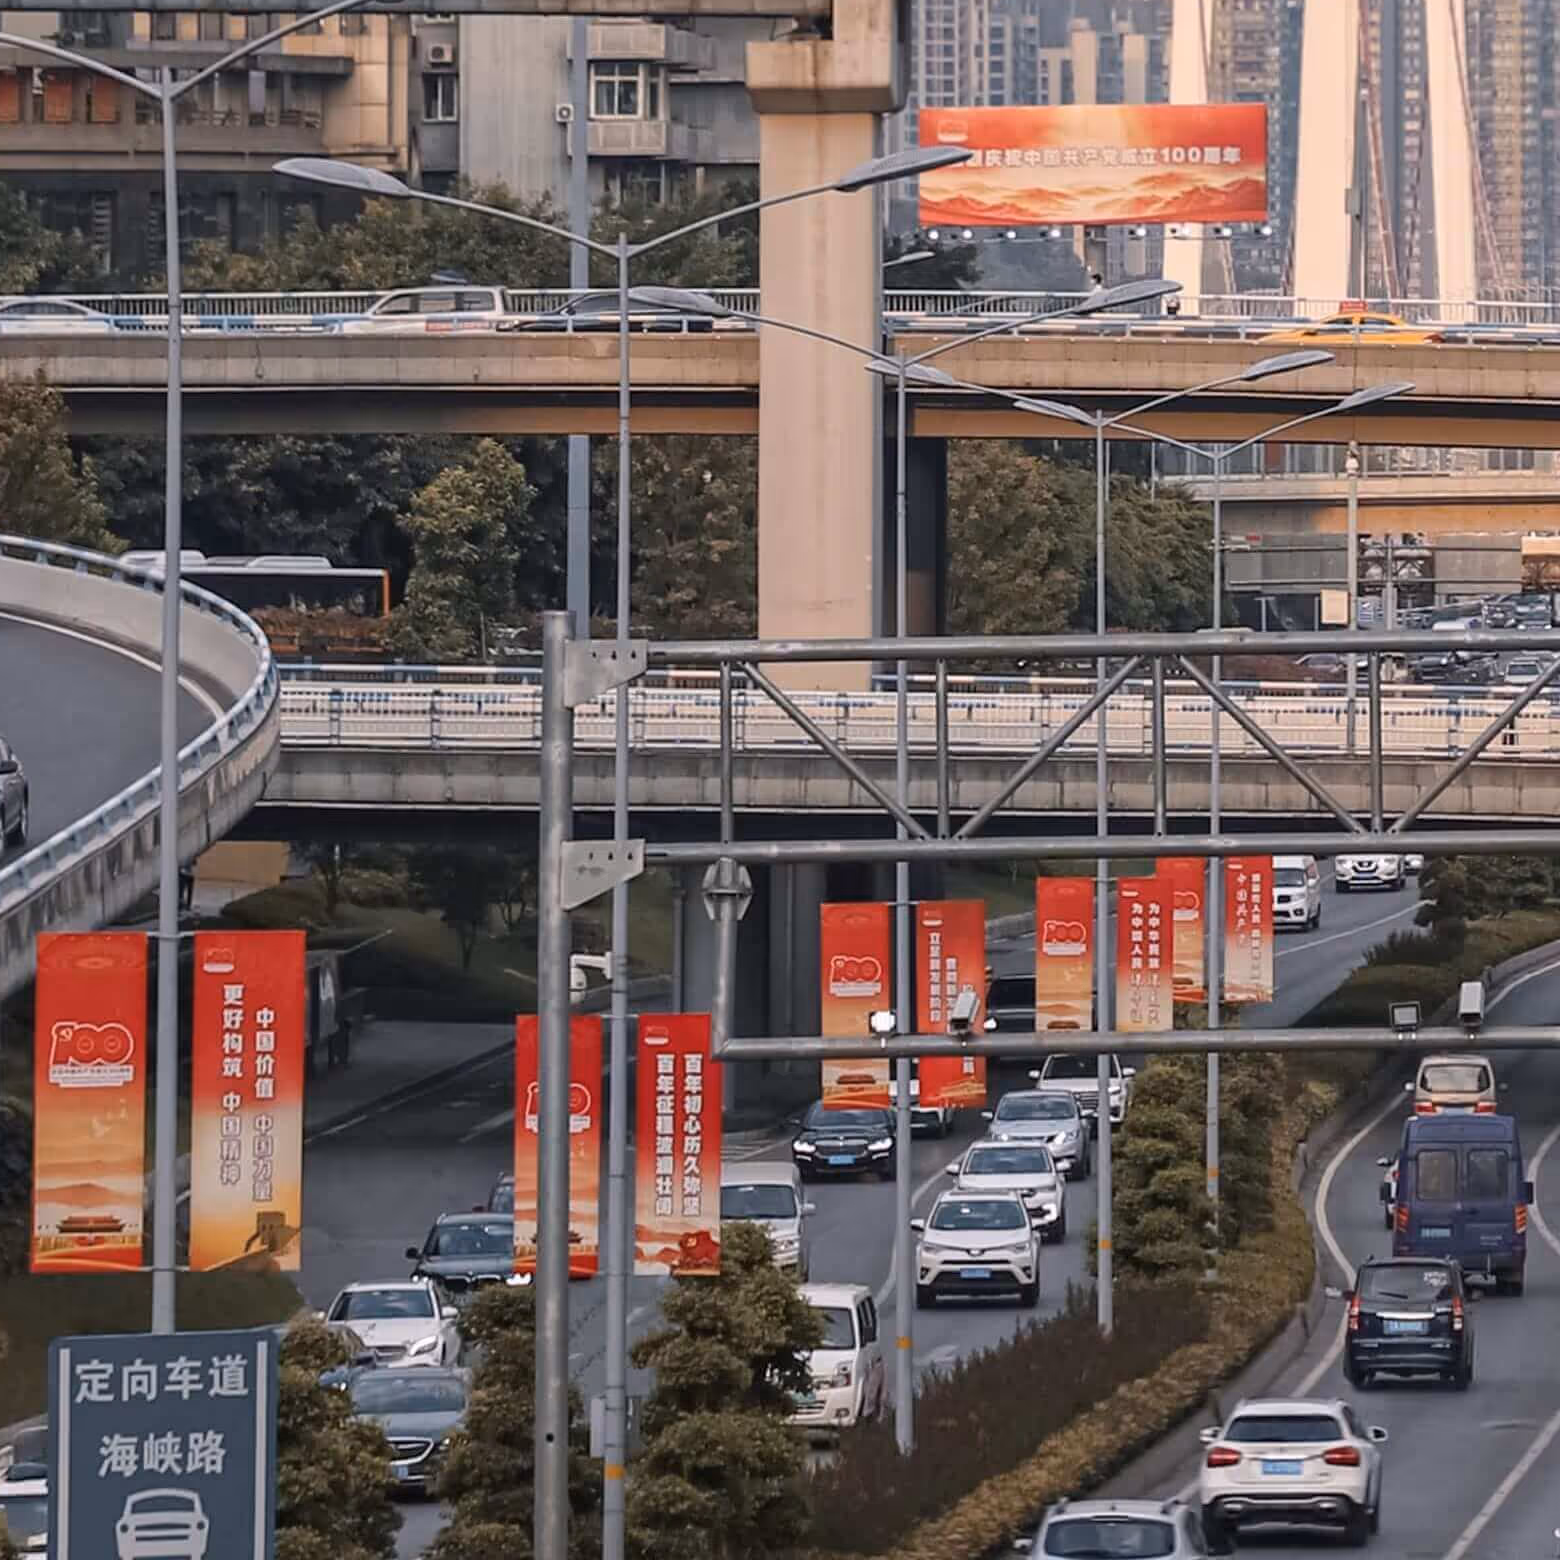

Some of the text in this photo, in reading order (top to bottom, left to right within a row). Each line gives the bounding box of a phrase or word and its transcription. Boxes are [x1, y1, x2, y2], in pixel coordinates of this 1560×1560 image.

[219, 983, 245, 1186] 更好构筑 中国精神
[252, 1006, 276, 1202] 中国价值 中国力量
[74, 1353, 250, 1403] 定向车道
[97, 1429, 227, 1478] 海峡路
